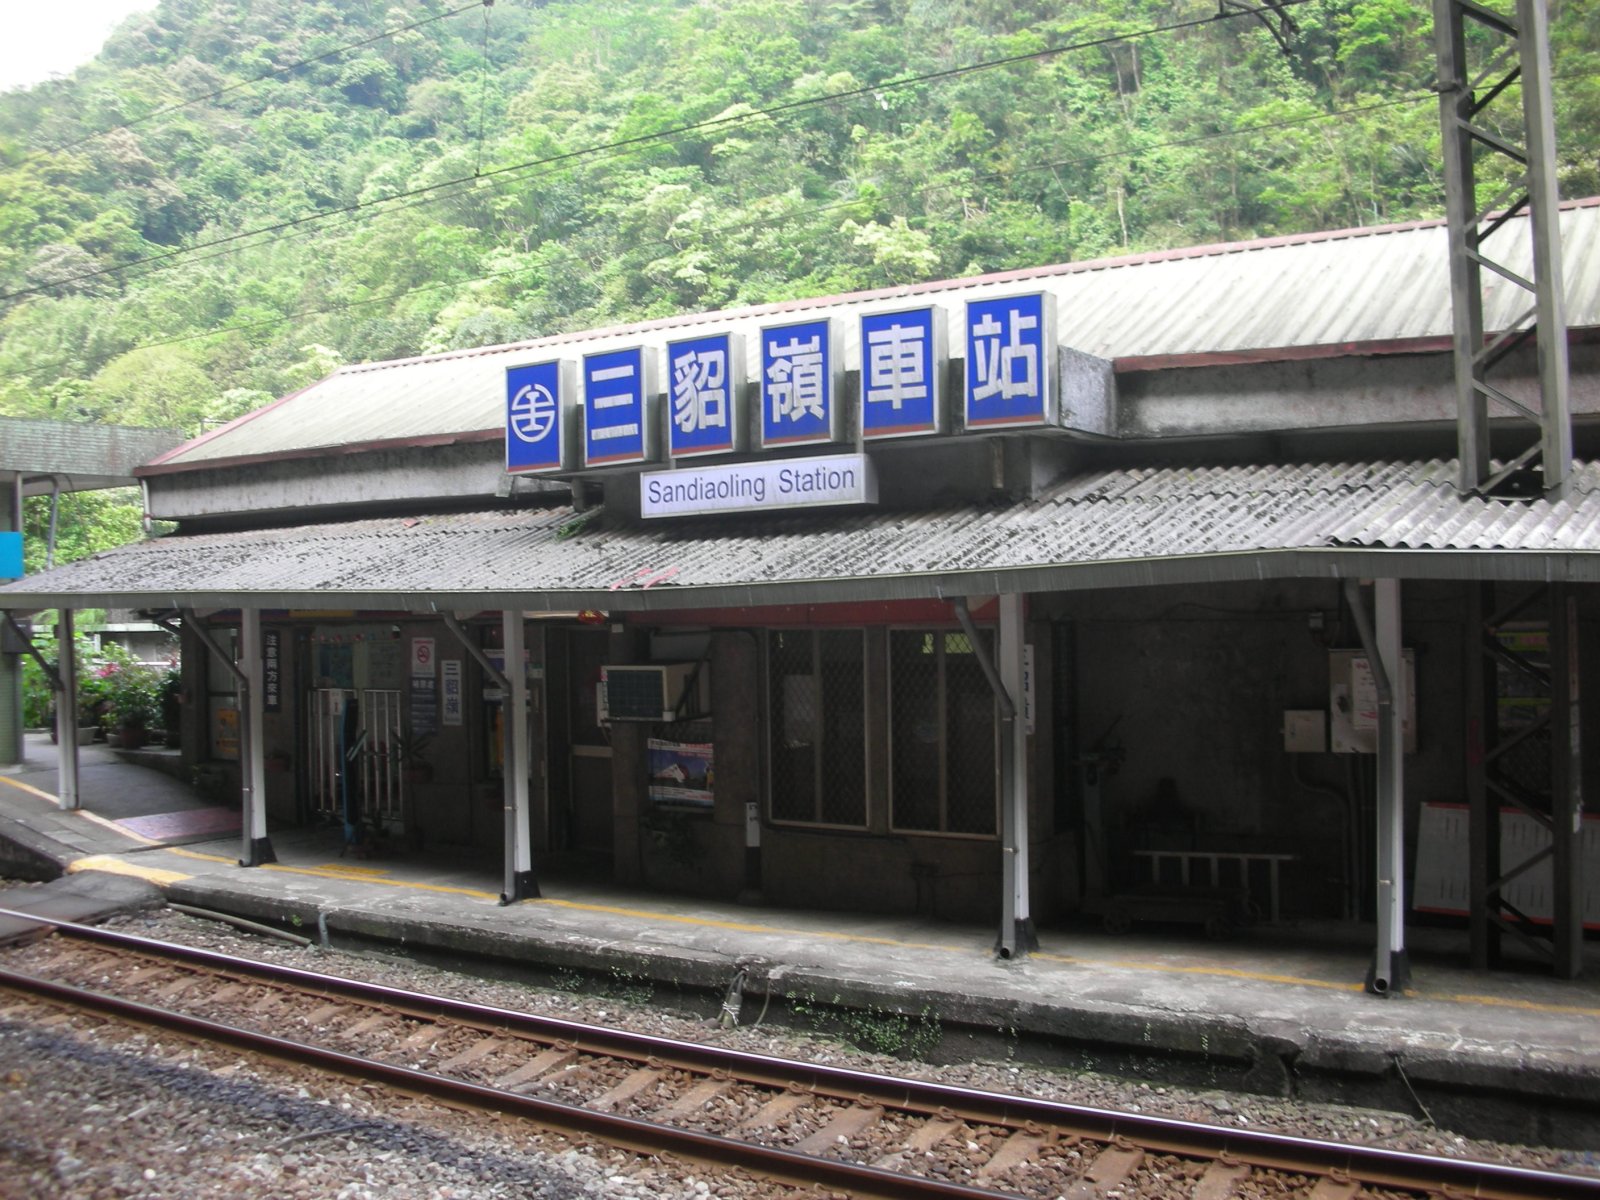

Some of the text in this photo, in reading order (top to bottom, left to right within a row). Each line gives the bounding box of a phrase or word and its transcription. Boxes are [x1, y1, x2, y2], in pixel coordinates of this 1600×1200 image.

[591, 309, 1038, 441] 三貂嶺車站
[648, 466, 855, 503] Sandiaoling Station
